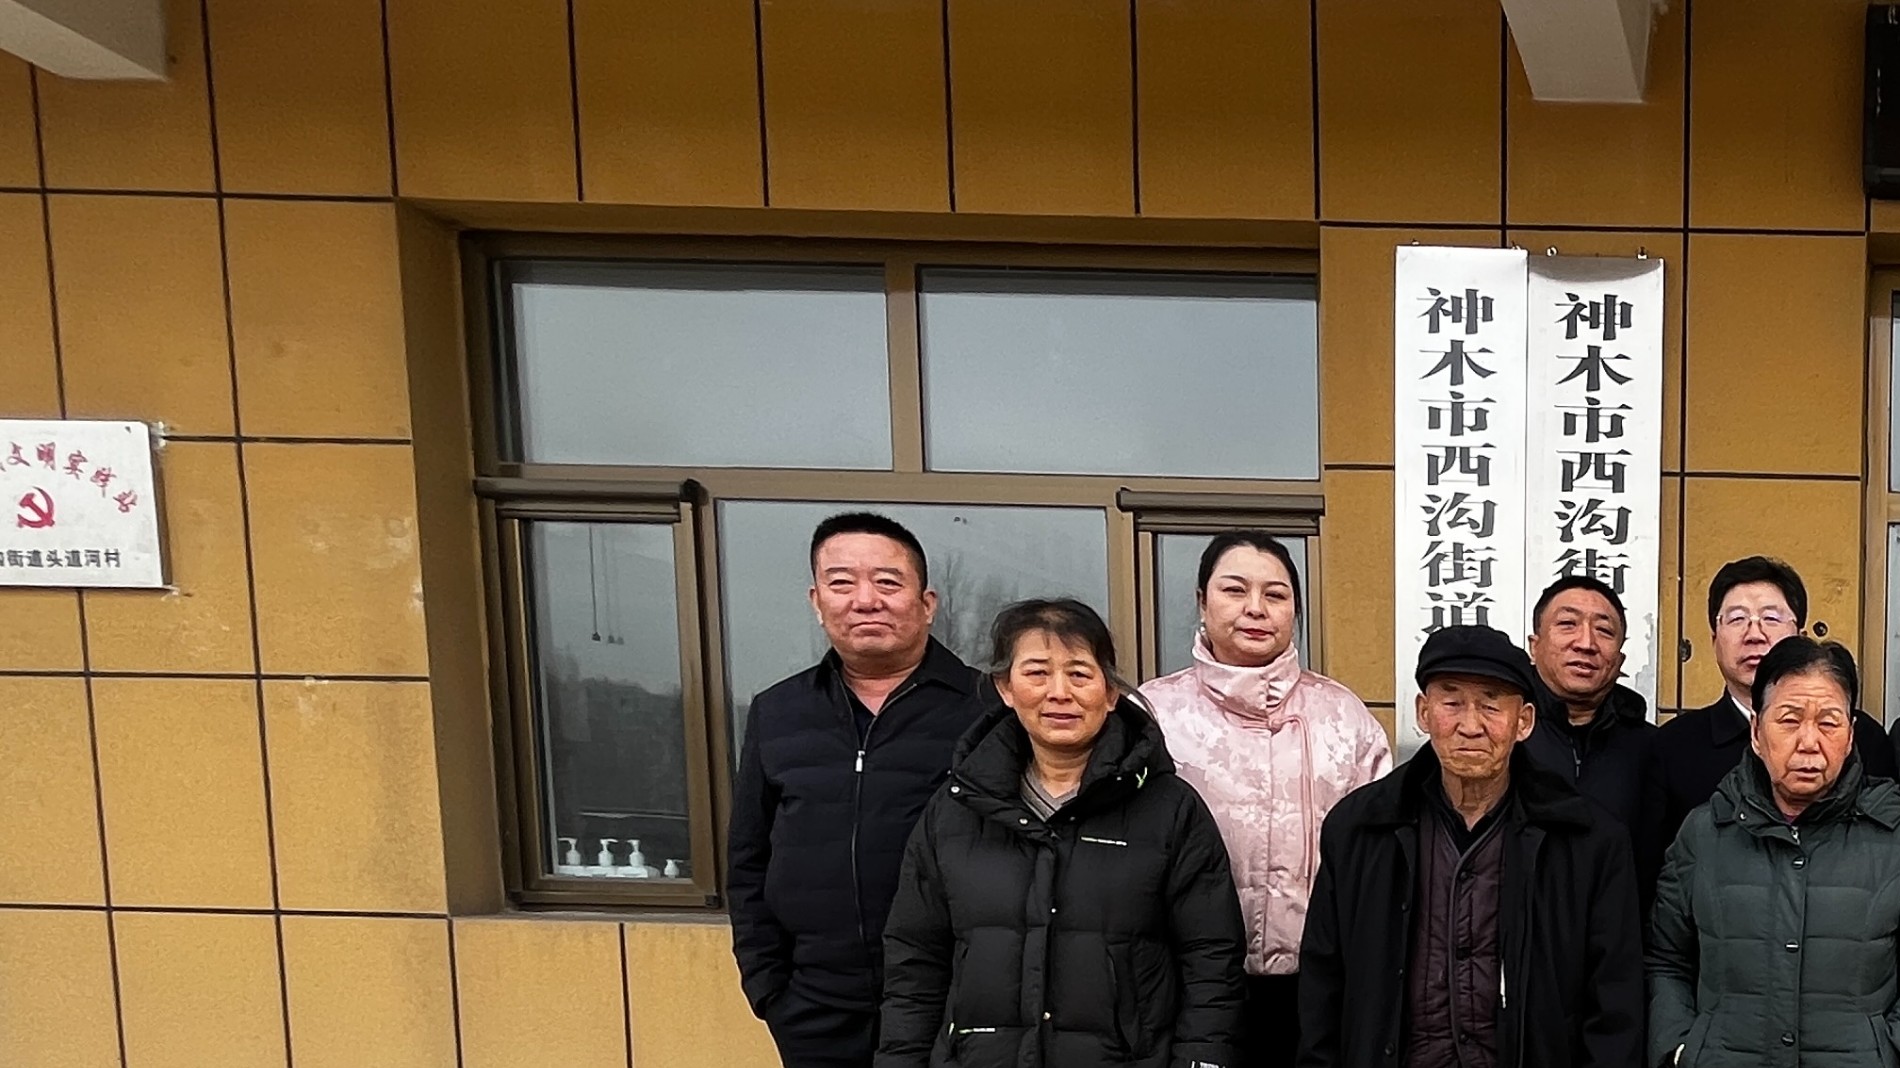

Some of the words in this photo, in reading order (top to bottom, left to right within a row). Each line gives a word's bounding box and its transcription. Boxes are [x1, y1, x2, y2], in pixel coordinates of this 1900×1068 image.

[0, 441, 138, 513] 文明实践站
